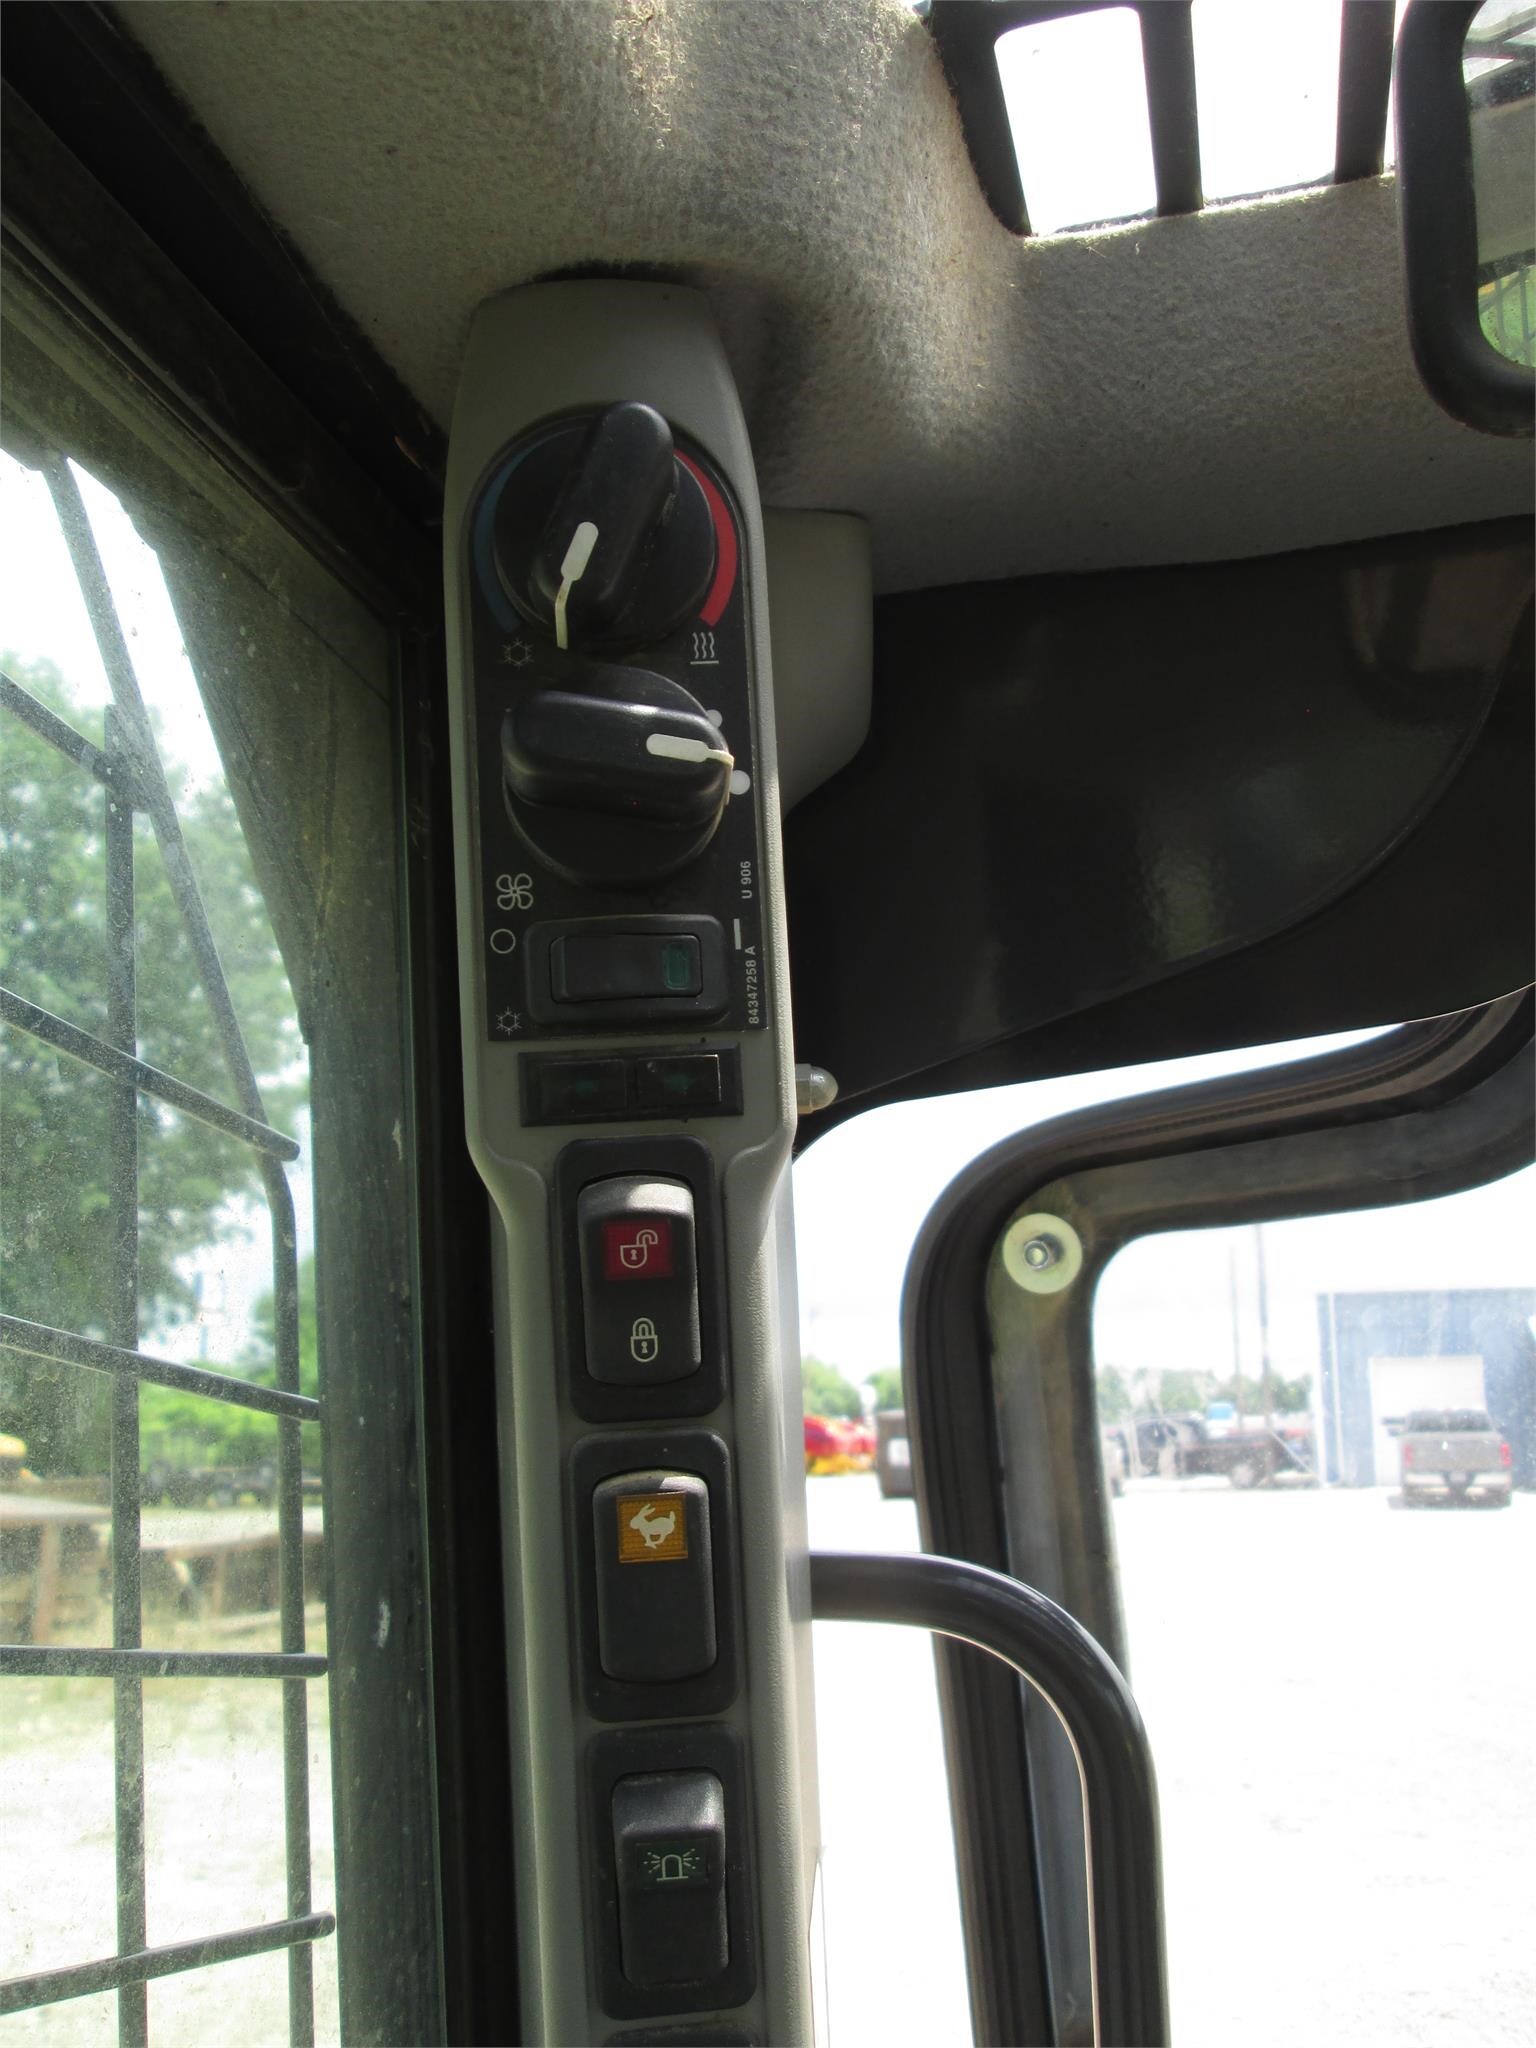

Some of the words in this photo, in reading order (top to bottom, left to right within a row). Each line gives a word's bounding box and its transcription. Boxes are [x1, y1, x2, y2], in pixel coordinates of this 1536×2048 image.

[740, 861, 752, 885] 906
[741, 890, 753, 899] U
[745, 945, 757, 956] A
[745, 959, 760, 1024] 84347258
